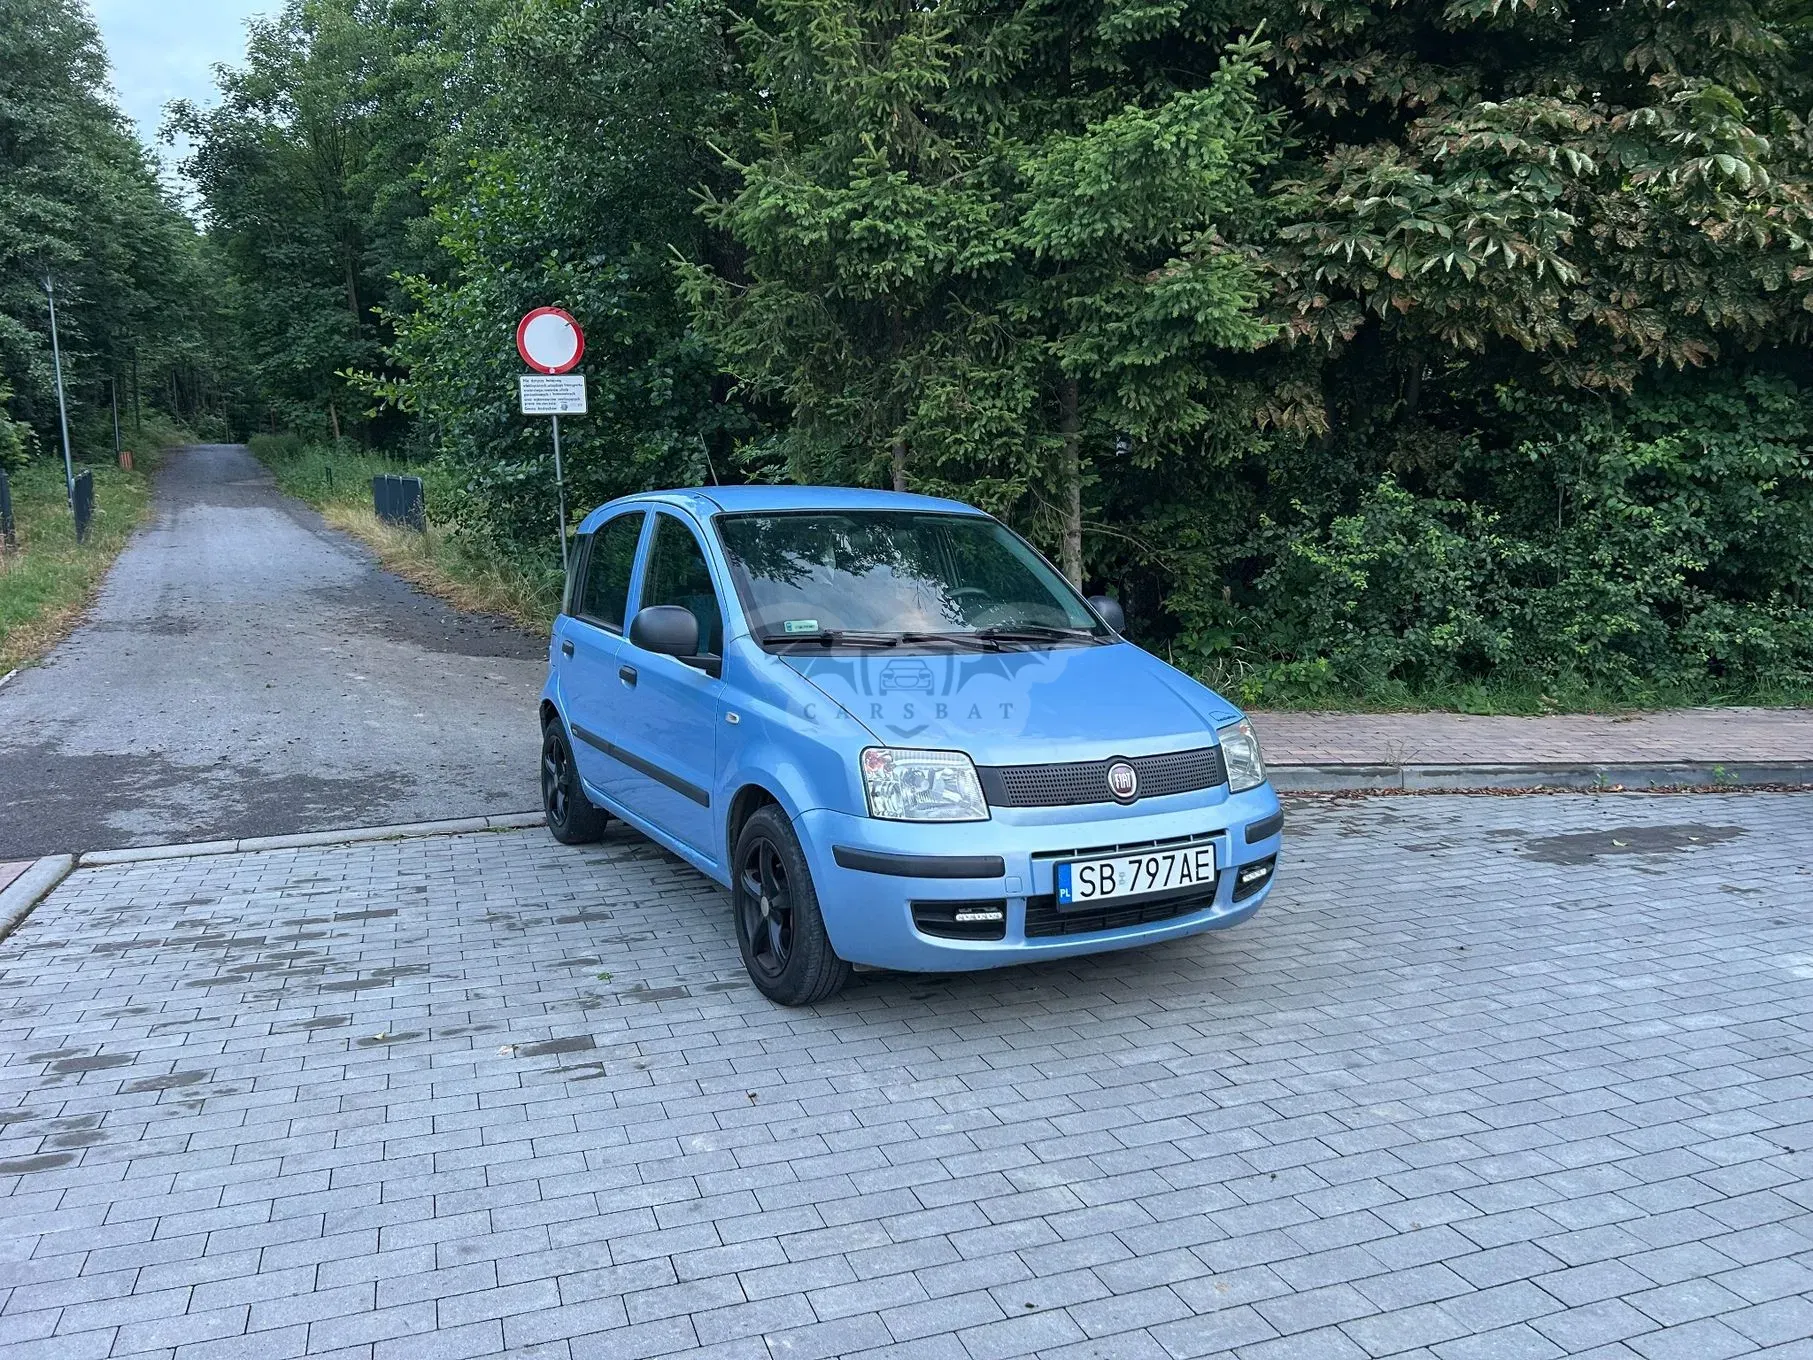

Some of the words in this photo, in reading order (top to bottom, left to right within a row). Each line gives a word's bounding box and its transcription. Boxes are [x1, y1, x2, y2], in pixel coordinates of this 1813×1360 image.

[1114, 772, 1131, 789] FIAT
[1079, 863, 1116, 897] SB
[1128, 849, 1210, 892] 797AE
[1060, 888, 1071, 898] PL
